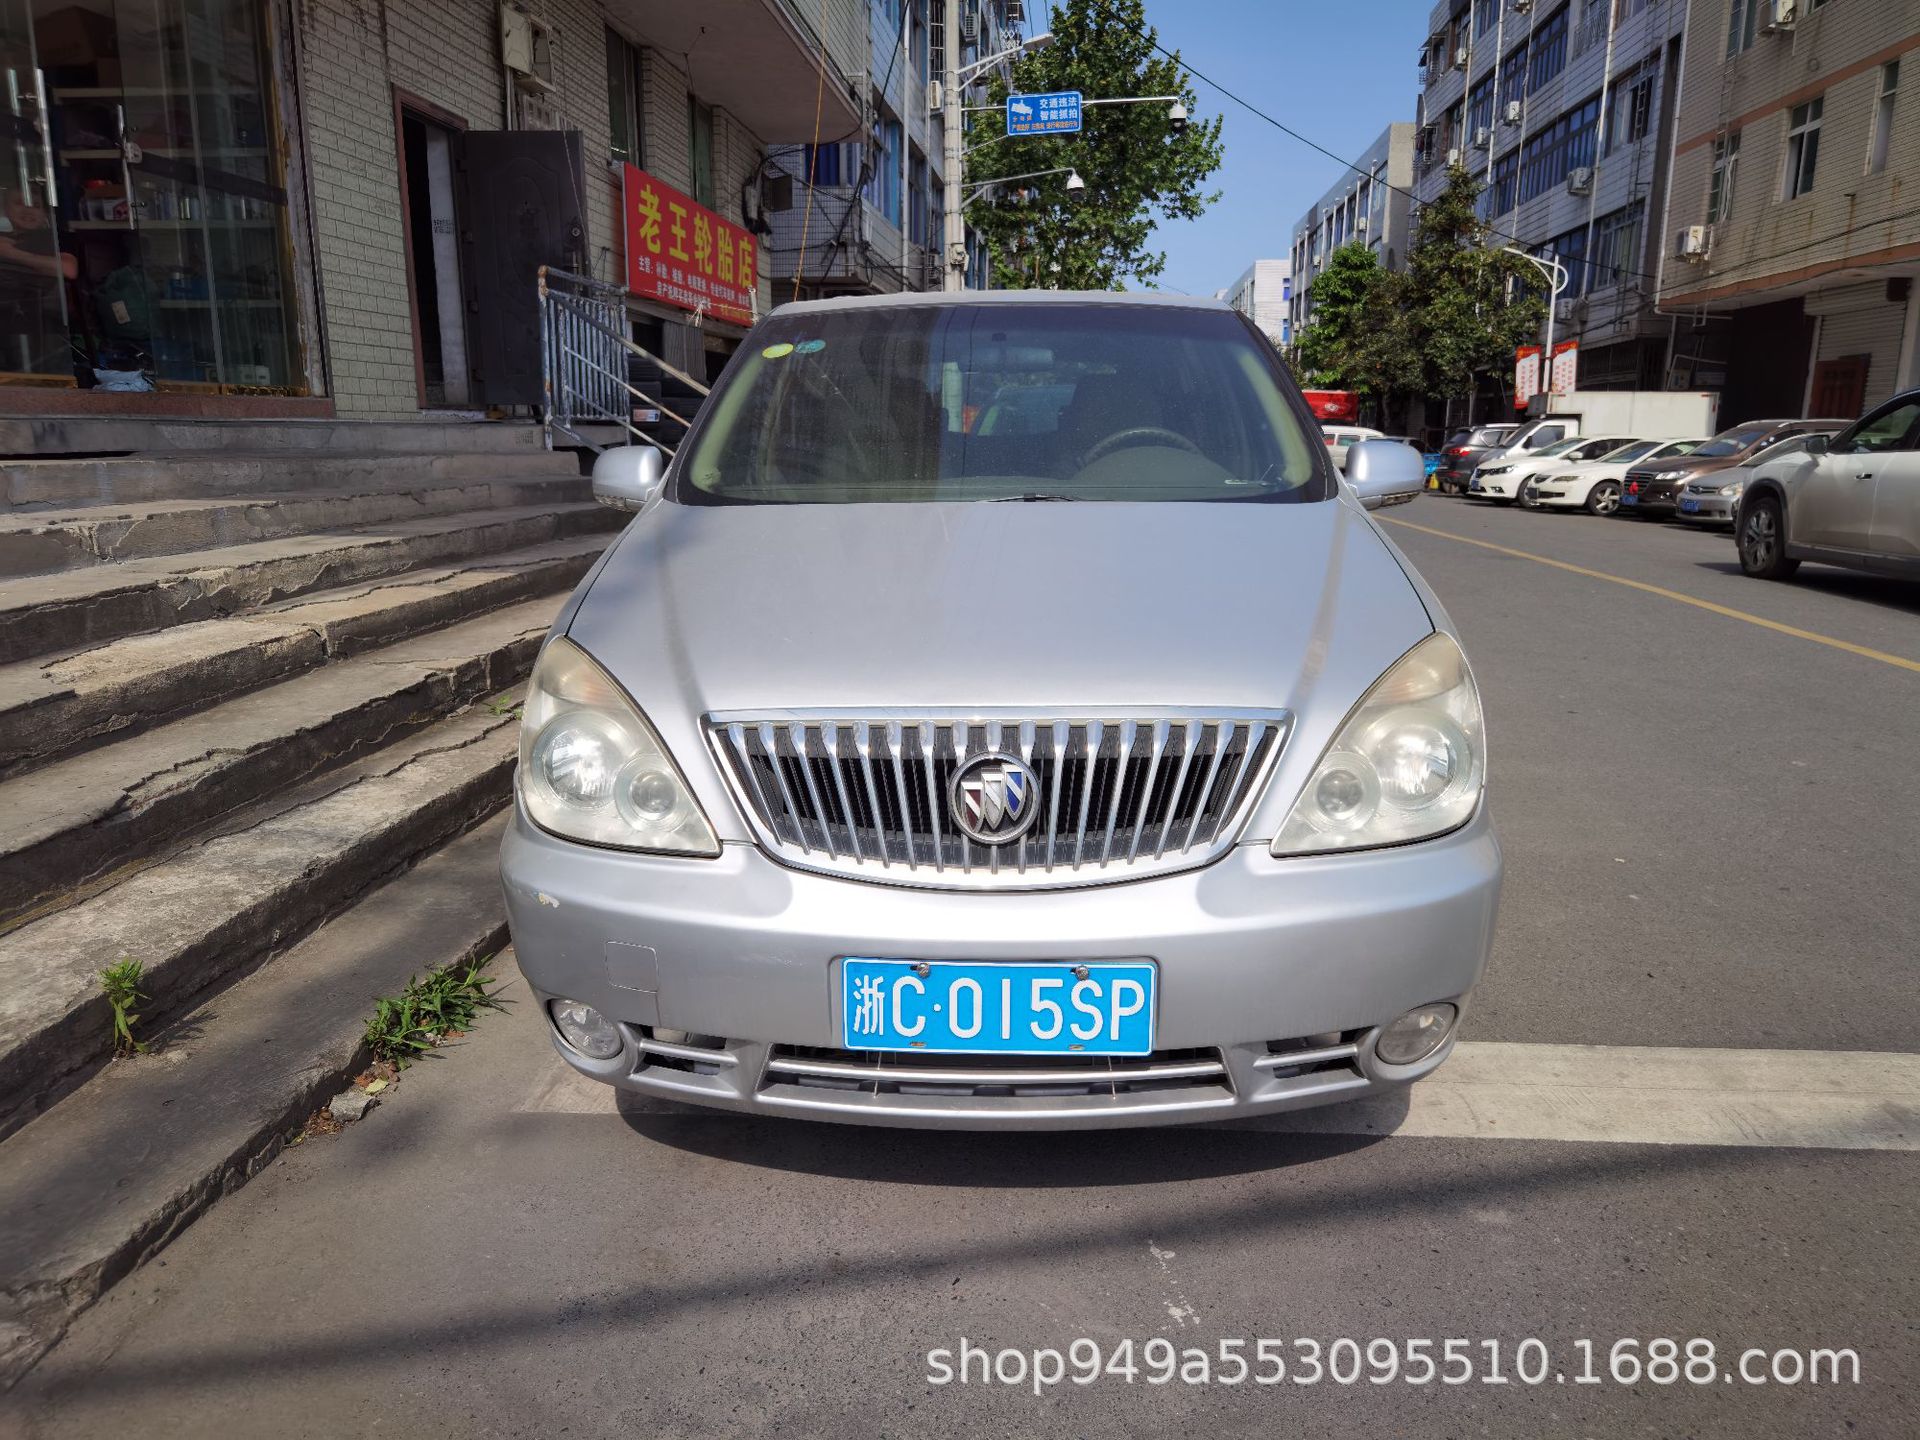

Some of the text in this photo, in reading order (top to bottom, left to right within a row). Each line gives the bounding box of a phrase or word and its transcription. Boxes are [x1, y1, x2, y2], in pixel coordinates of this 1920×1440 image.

[1040, 96, 1077, 109] 交通违法
[1040, 109, 1078, 121] 智能抓拍
[638, 184, 753, 288] 老王轮胎店
